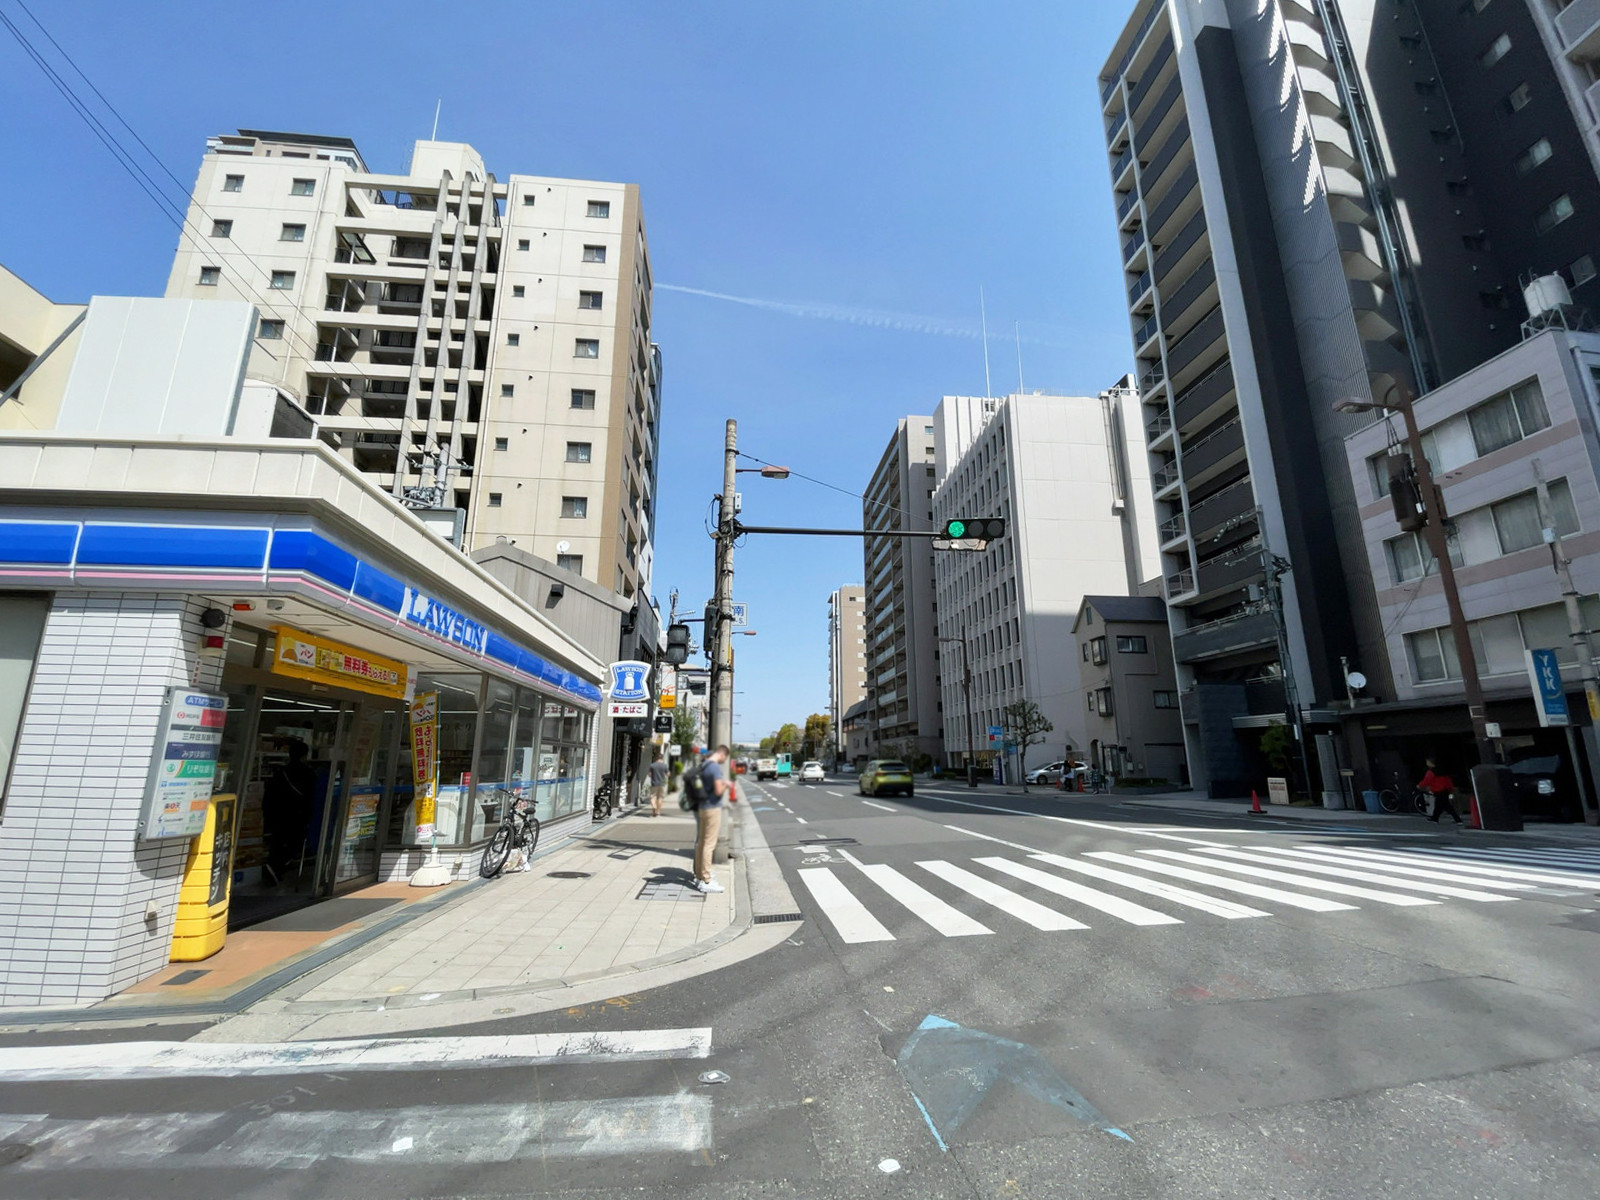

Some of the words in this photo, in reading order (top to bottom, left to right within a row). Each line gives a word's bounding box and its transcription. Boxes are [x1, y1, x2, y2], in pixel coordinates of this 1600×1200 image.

[406, 586, 486, 652] LAWSON
[733, 605, 745, 617] 南
[1537, 655, 1557, 690] YKK
[612, 706, 642, 714] 酒・たばこ
